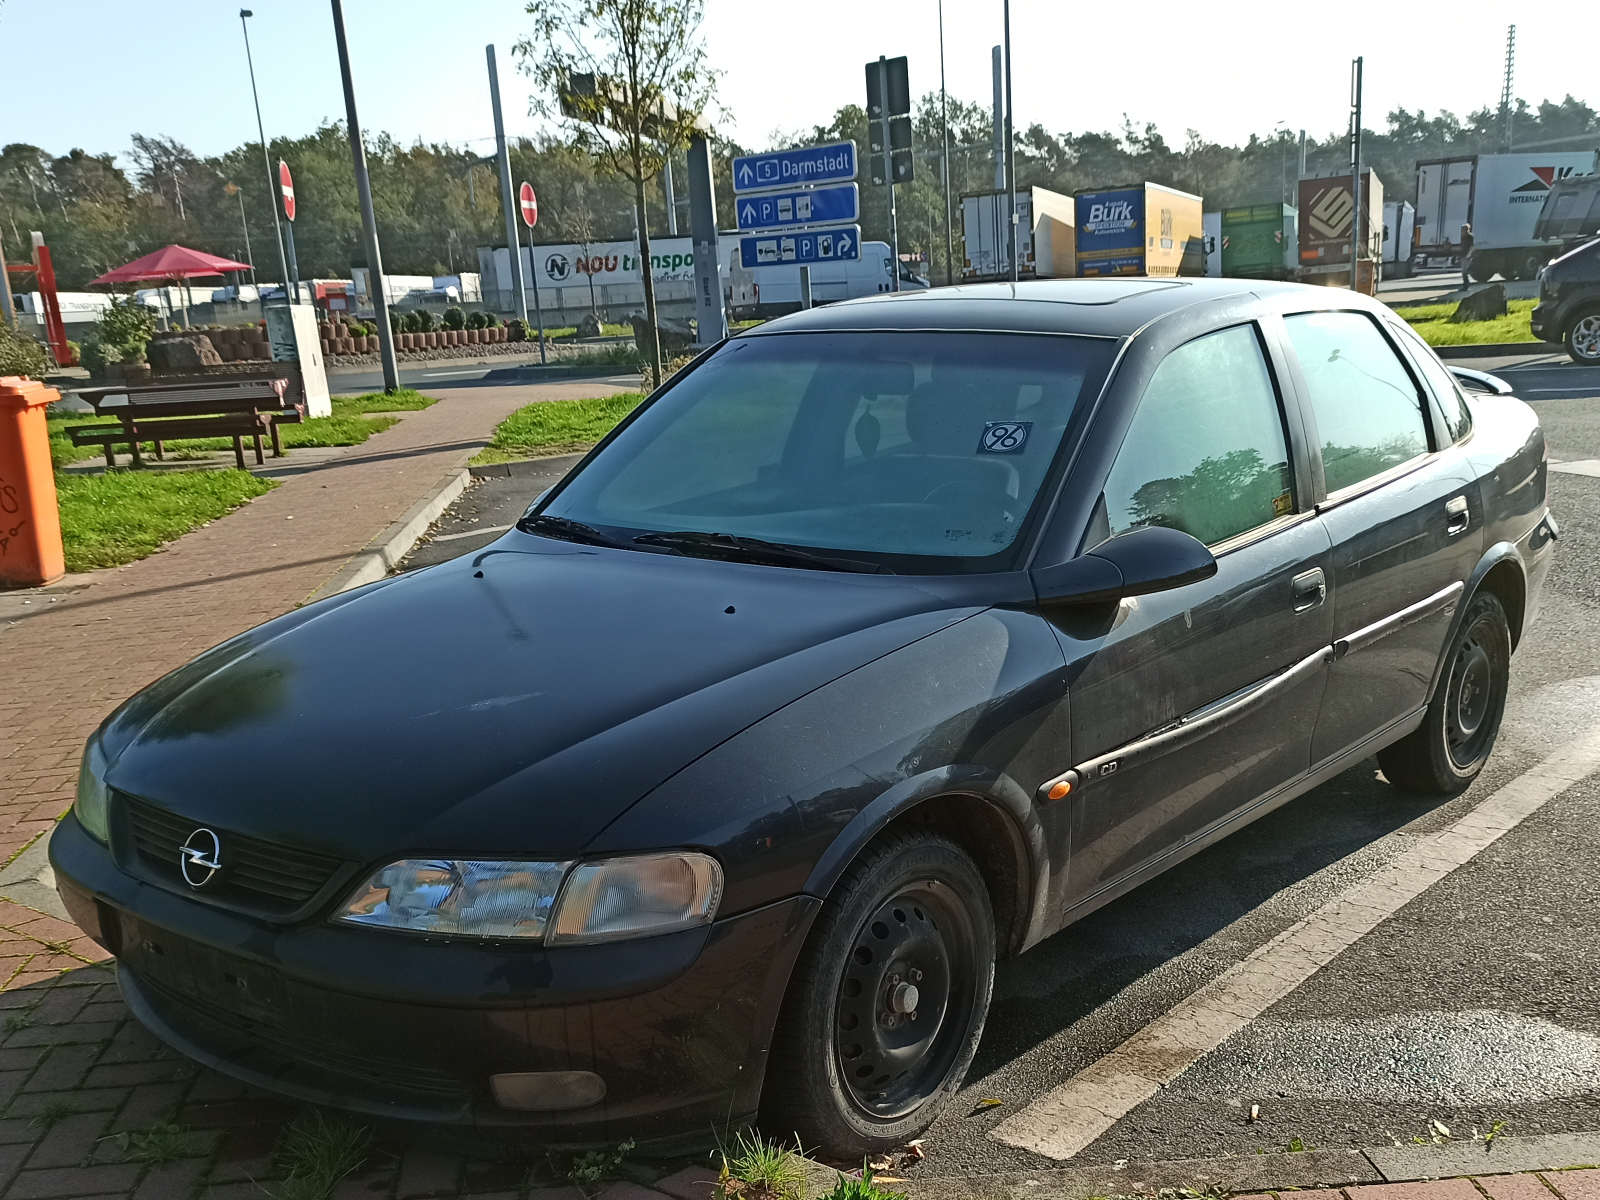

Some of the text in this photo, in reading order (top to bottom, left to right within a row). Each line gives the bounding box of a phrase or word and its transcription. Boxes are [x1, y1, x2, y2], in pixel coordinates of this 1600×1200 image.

[764, 152, 849, 178] 5 Darmstadt
[1508, 195, 1548, 204] INTERNATI
[762, 203, 771, 220] P
[802, 239, 811, 257] P
[575, 255, 619, 274] NOU
[1100, 761, 1118, 776] CD
